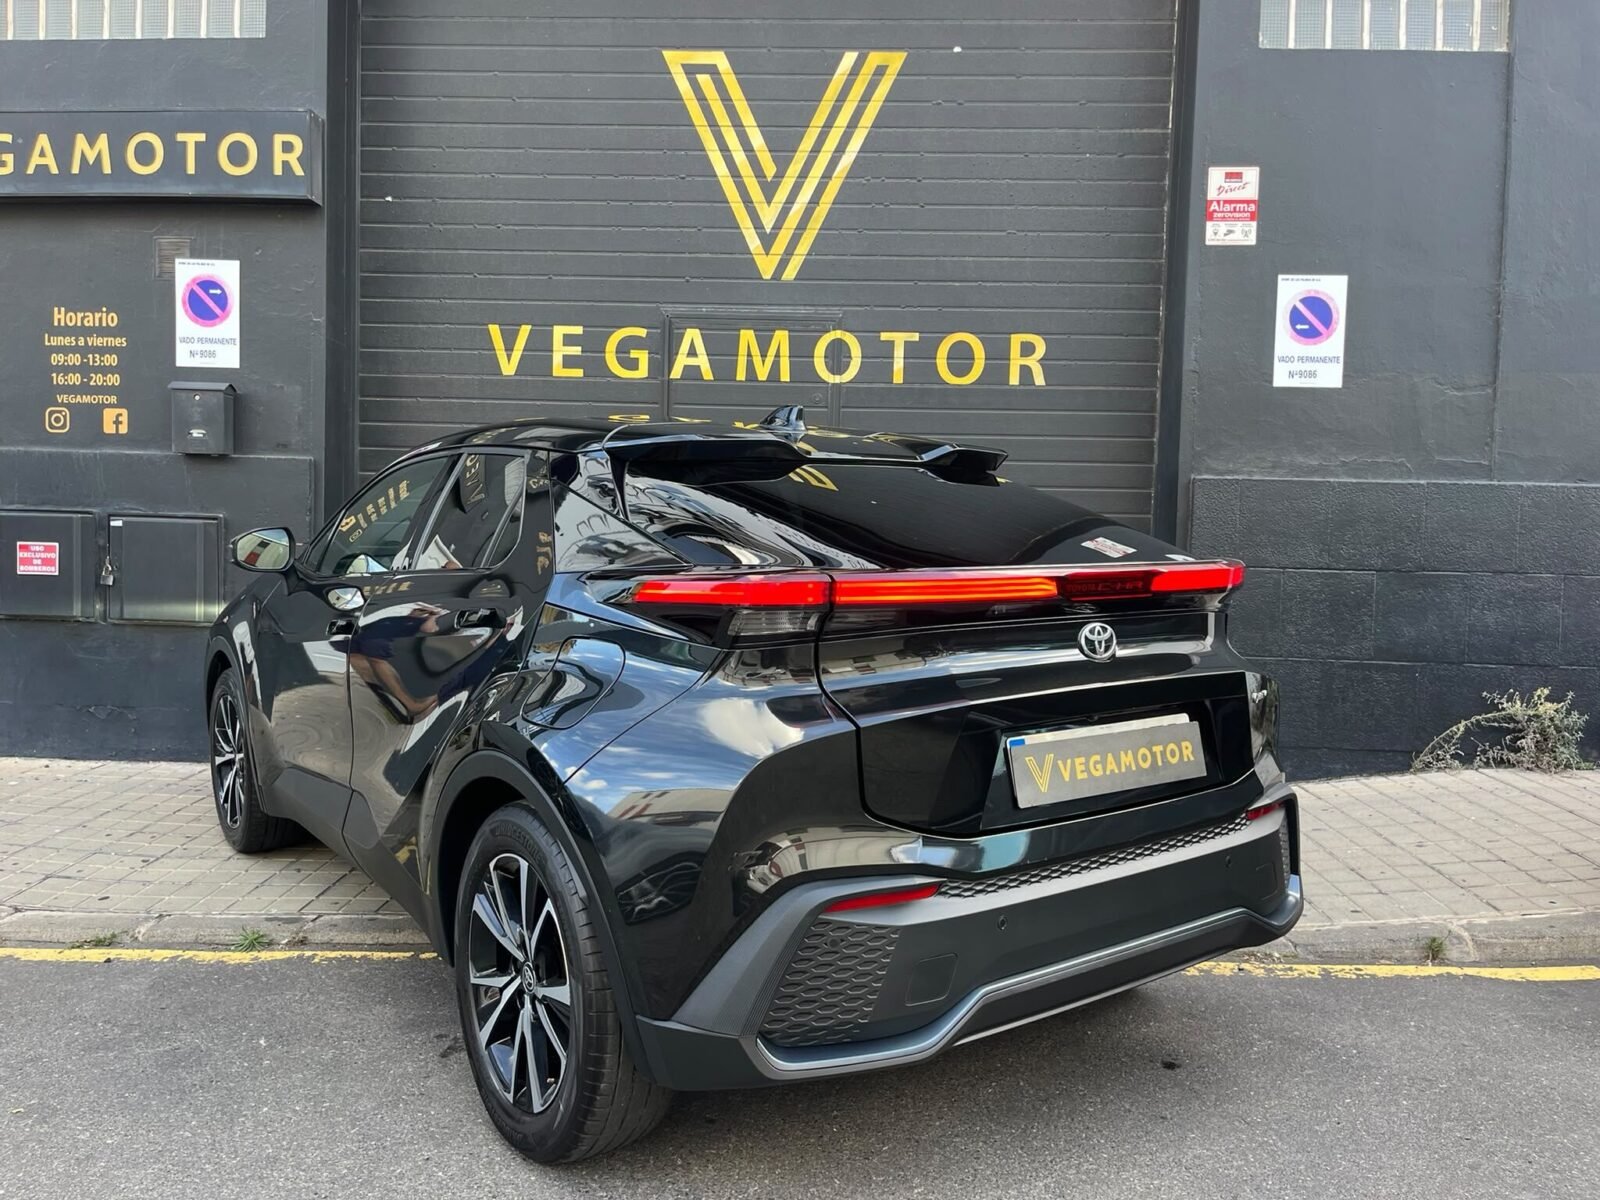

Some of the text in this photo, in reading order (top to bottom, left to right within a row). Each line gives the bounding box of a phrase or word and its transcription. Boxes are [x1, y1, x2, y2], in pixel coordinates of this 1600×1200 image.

[1209, 200, 1256, 212] Alarma
[53, 306, 118, 327] Horario
[44, 333, 127, 347] Lunes a viernes
[197, 337, 237, 346] PERMANENTE
[51, 353, 81, 366] 09:00
[487, 324, 1047, 386] VEGAMOTOR
[1277, 356, 1341, 365] VADO PERMANENTE
[51, 373, 81, 385] 16:00
[89, 373, 121, 386] 20:00
[56, 395, 118, 404] VEGAMOTOR
[19, 551, 56, 559] EXCLUSIVO
[1057, 740, 1195, 782] VEGAMOTOR
